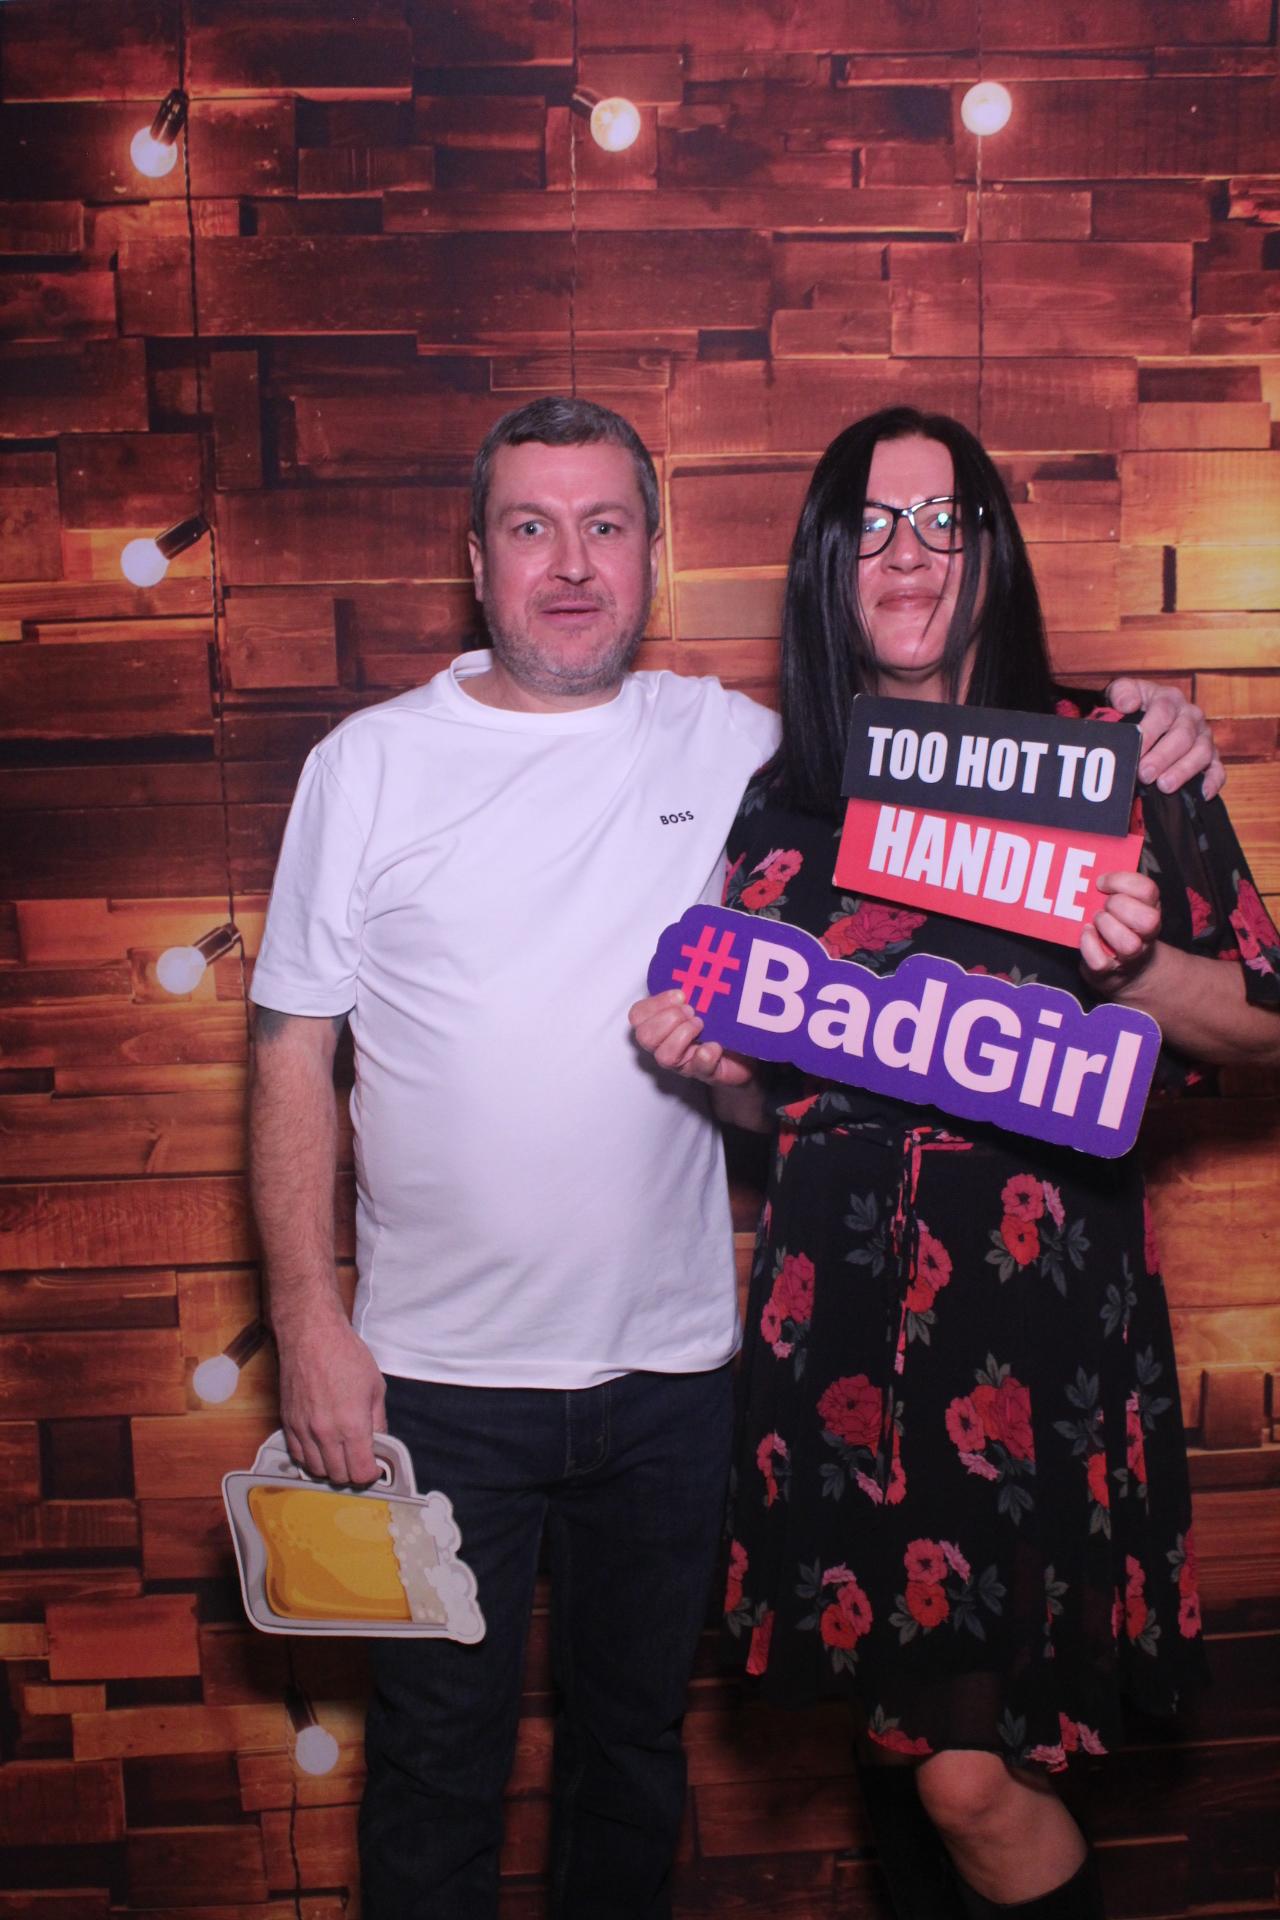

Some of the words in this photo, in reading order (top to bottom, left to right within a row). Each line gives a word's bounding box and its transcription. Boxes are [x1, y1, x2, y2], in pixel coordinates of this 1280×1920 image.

[867, 726, 948, 784] TOO
[955, 735, 1049, 794] HOT
[1057, 744, 1116, 803] TO
[659, 810, 695, 825] BOSS
[868, 805, 1097, 922] HANDLE
[671, 925, 1143, 1130] #BadGirl
